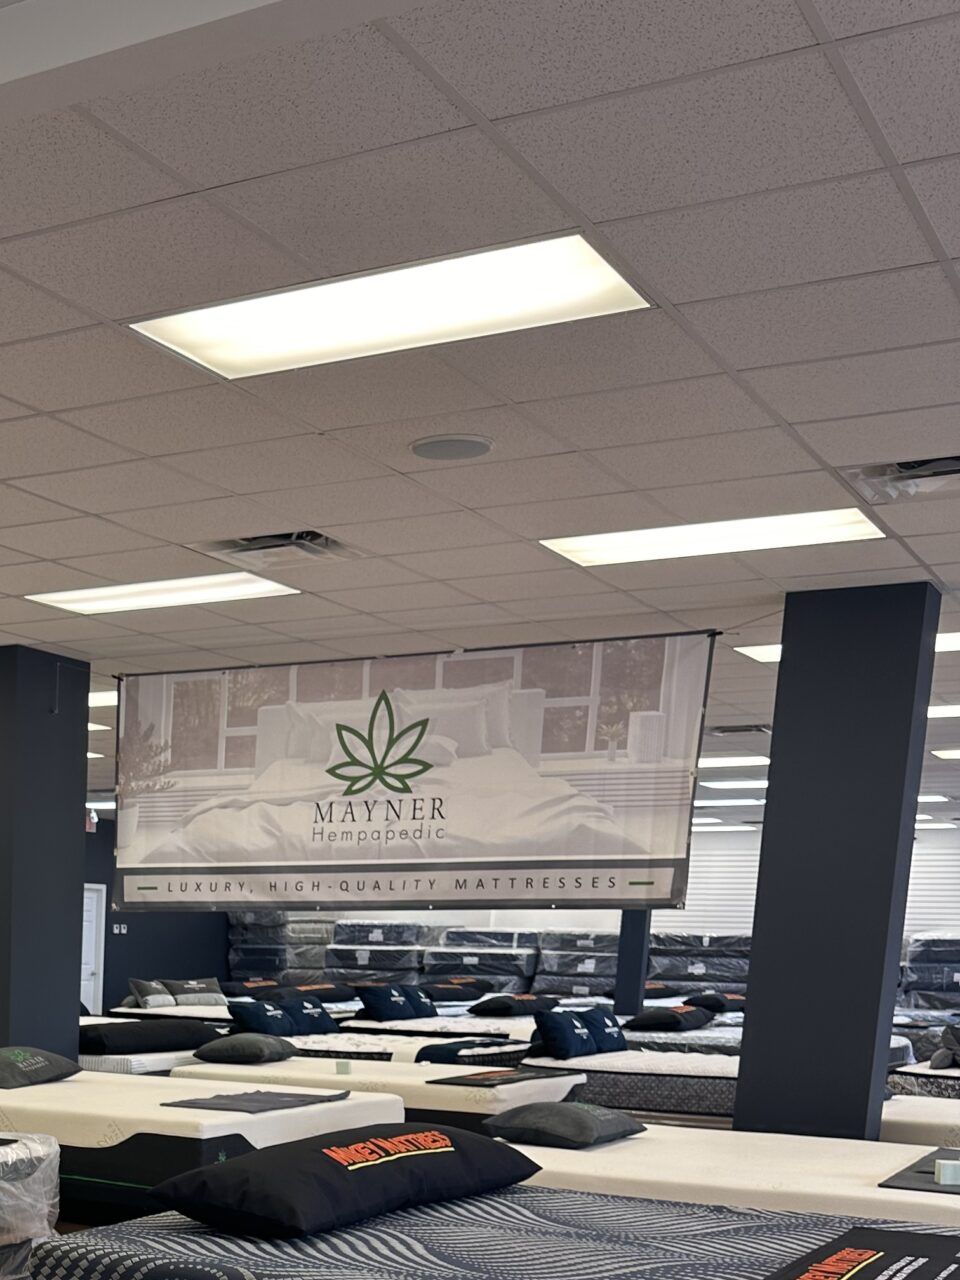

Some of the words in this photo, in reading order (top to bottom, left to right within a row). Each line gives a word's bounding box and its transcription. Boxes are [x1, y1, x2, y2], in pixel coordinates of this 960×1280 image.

[313, 797, 446, 823] MAYNER
[312, 822, 445, 846] Hempapedic
[167, 881, 254, 894] LUXURY,
[269, 878, 437, 892] HIGH-QUALITY
[455, 876, 617, 890] MATTRESSES
[321, 1141, 386, 1166] MIKEY
[369, 1130, 452, 1155] MATTRESS
